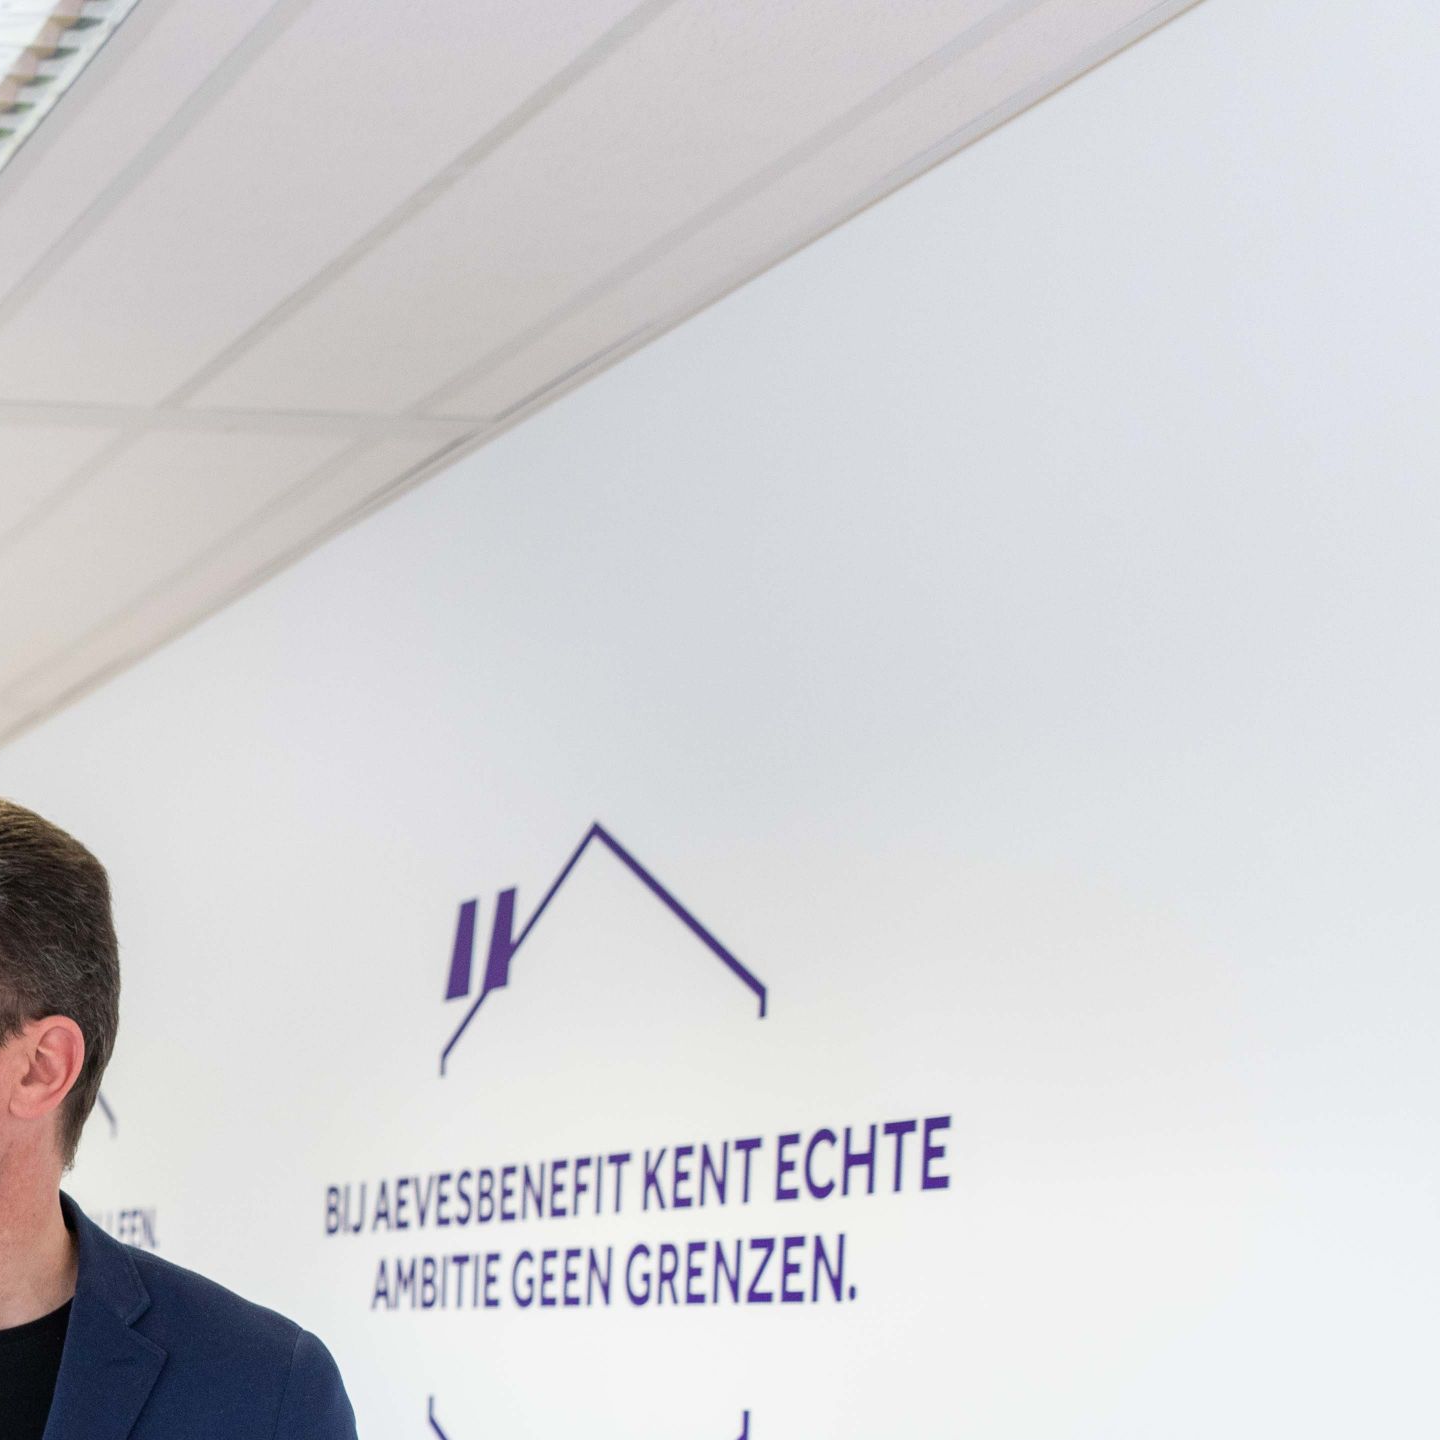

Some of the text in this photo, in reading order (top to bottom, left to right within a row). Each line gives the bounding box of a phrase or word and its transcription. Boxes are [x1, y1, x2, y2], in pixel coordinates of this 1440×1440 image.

[324, 1114, 953, 1237] BIJ AEVESBENEFIT KENT ECHTE
[370, 1232, 858, 1310] AMBITIE GEEN GRENZEN.
